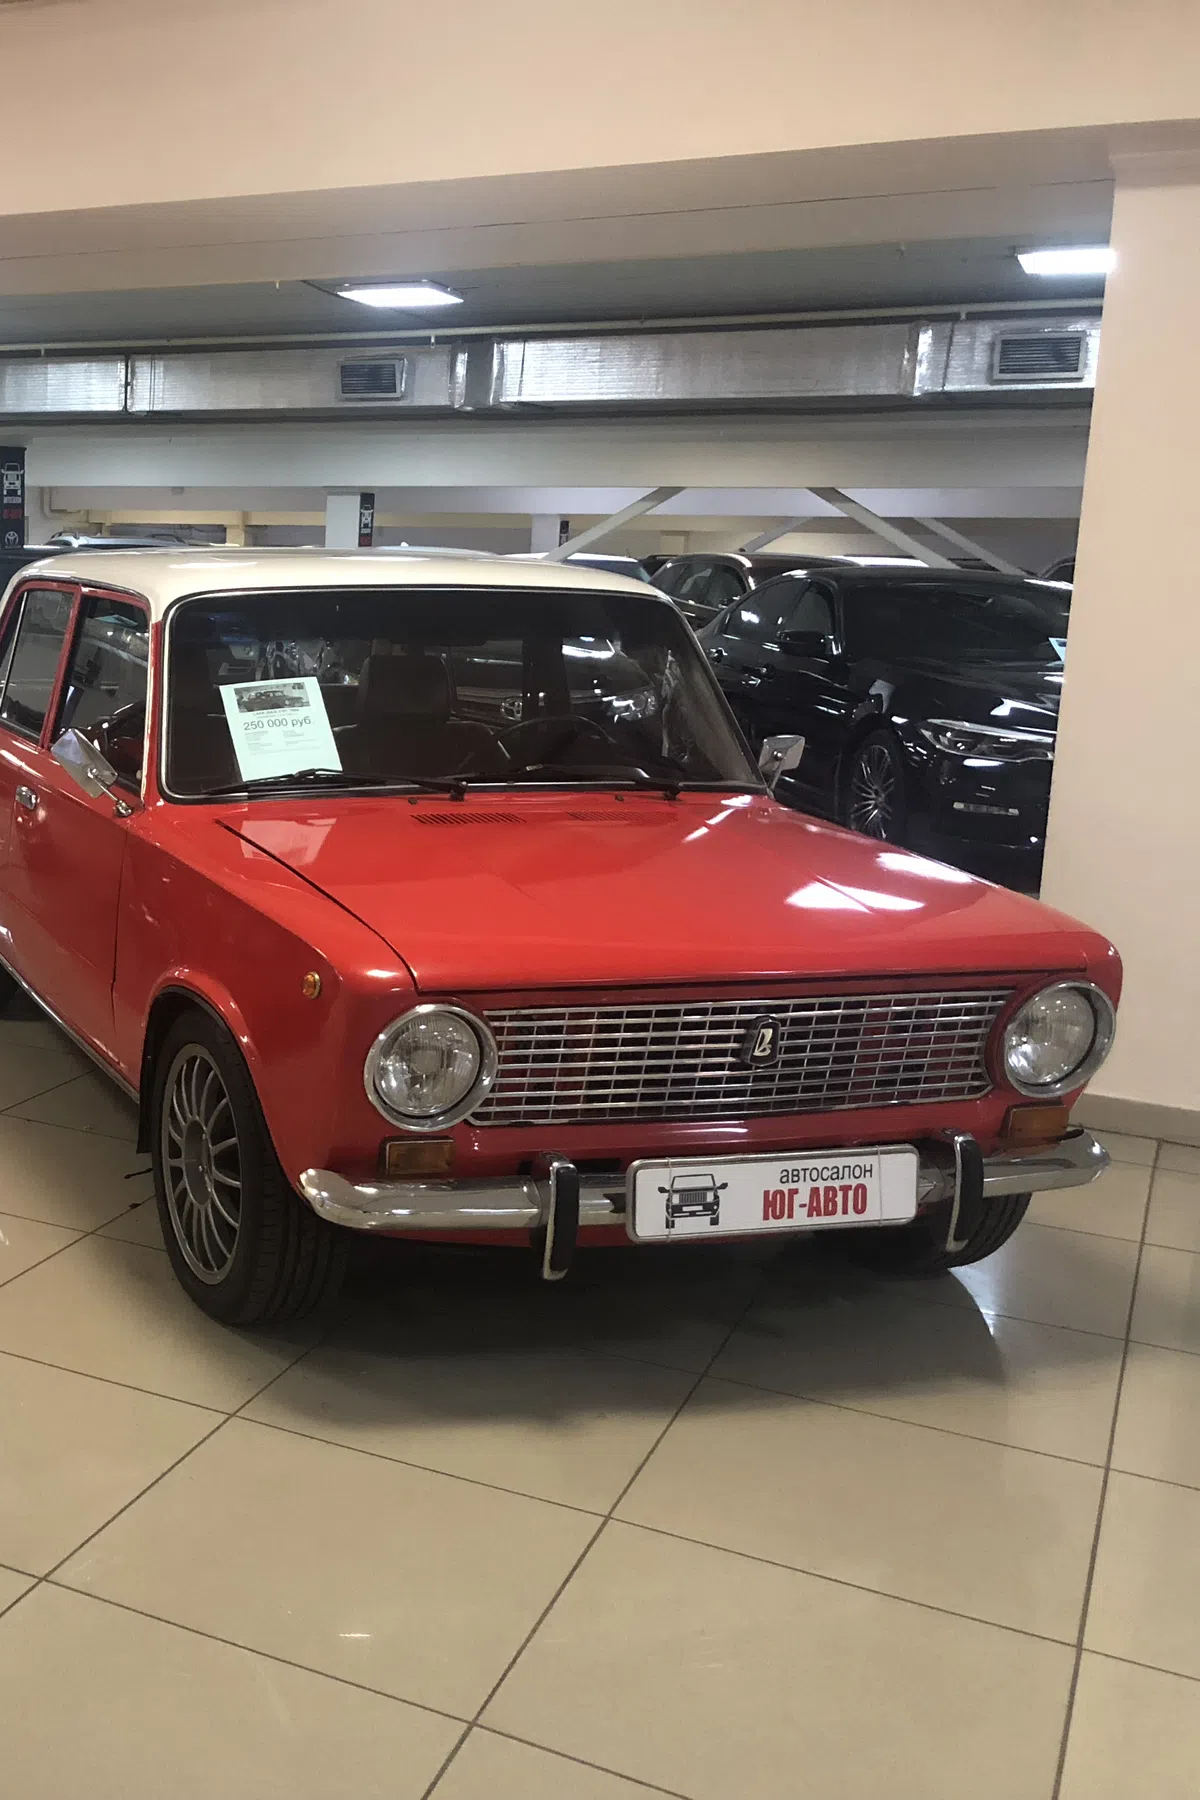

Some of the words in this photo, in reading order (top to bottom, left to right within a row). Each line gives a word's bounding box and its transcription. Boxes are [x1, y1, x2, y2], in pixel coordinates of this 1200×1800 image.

[243, 719, 265, 731] 250
[267, 717, 288, 728] 000
[779, 1163, 873, 1184] автосалон
[762, 1183, 867, 1221] ЮГ-АВТО
